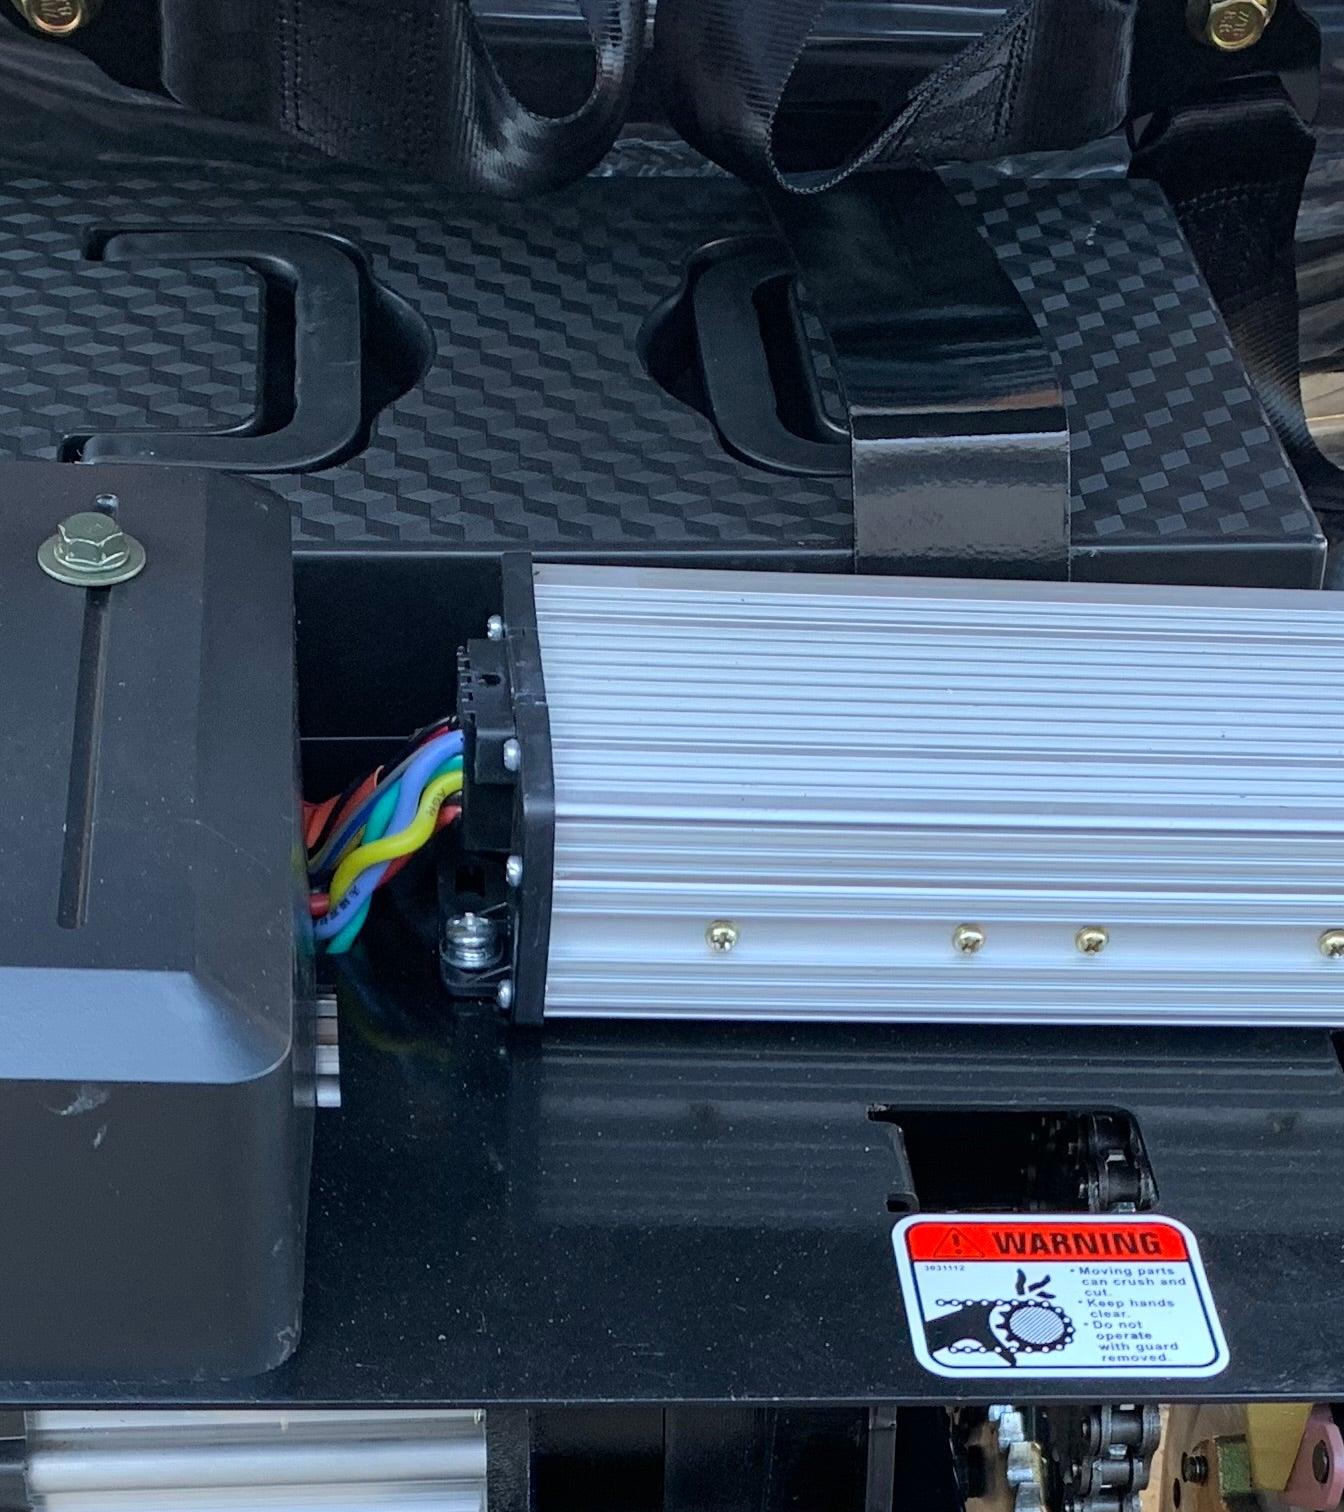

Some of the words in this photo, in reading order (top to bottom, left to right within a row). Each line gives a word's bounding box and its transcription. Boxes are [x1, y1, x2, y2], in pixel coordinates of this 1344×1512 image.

[991, 1231, 1162, 1255] WARNING
[1079, 1267, 1132, 1276] Moving
[1138, 1267, 1175, 1276] parts
[1113, 1278, 1154, 1286] crush
[1160, 1278, 1186, 1286] and
[1087, 1299, 1124, 1308] Keep
[1130, 1299, 1175, 1307] hands
[1093, 1320, 1113, 1329] Do
[1119, 1320, 1143, 1329] not
[1096, 1332, 1152, 1341] operate
[1099, 1343, 1130, 1351] with
[1136, 1342, 1179, 1352] guard
